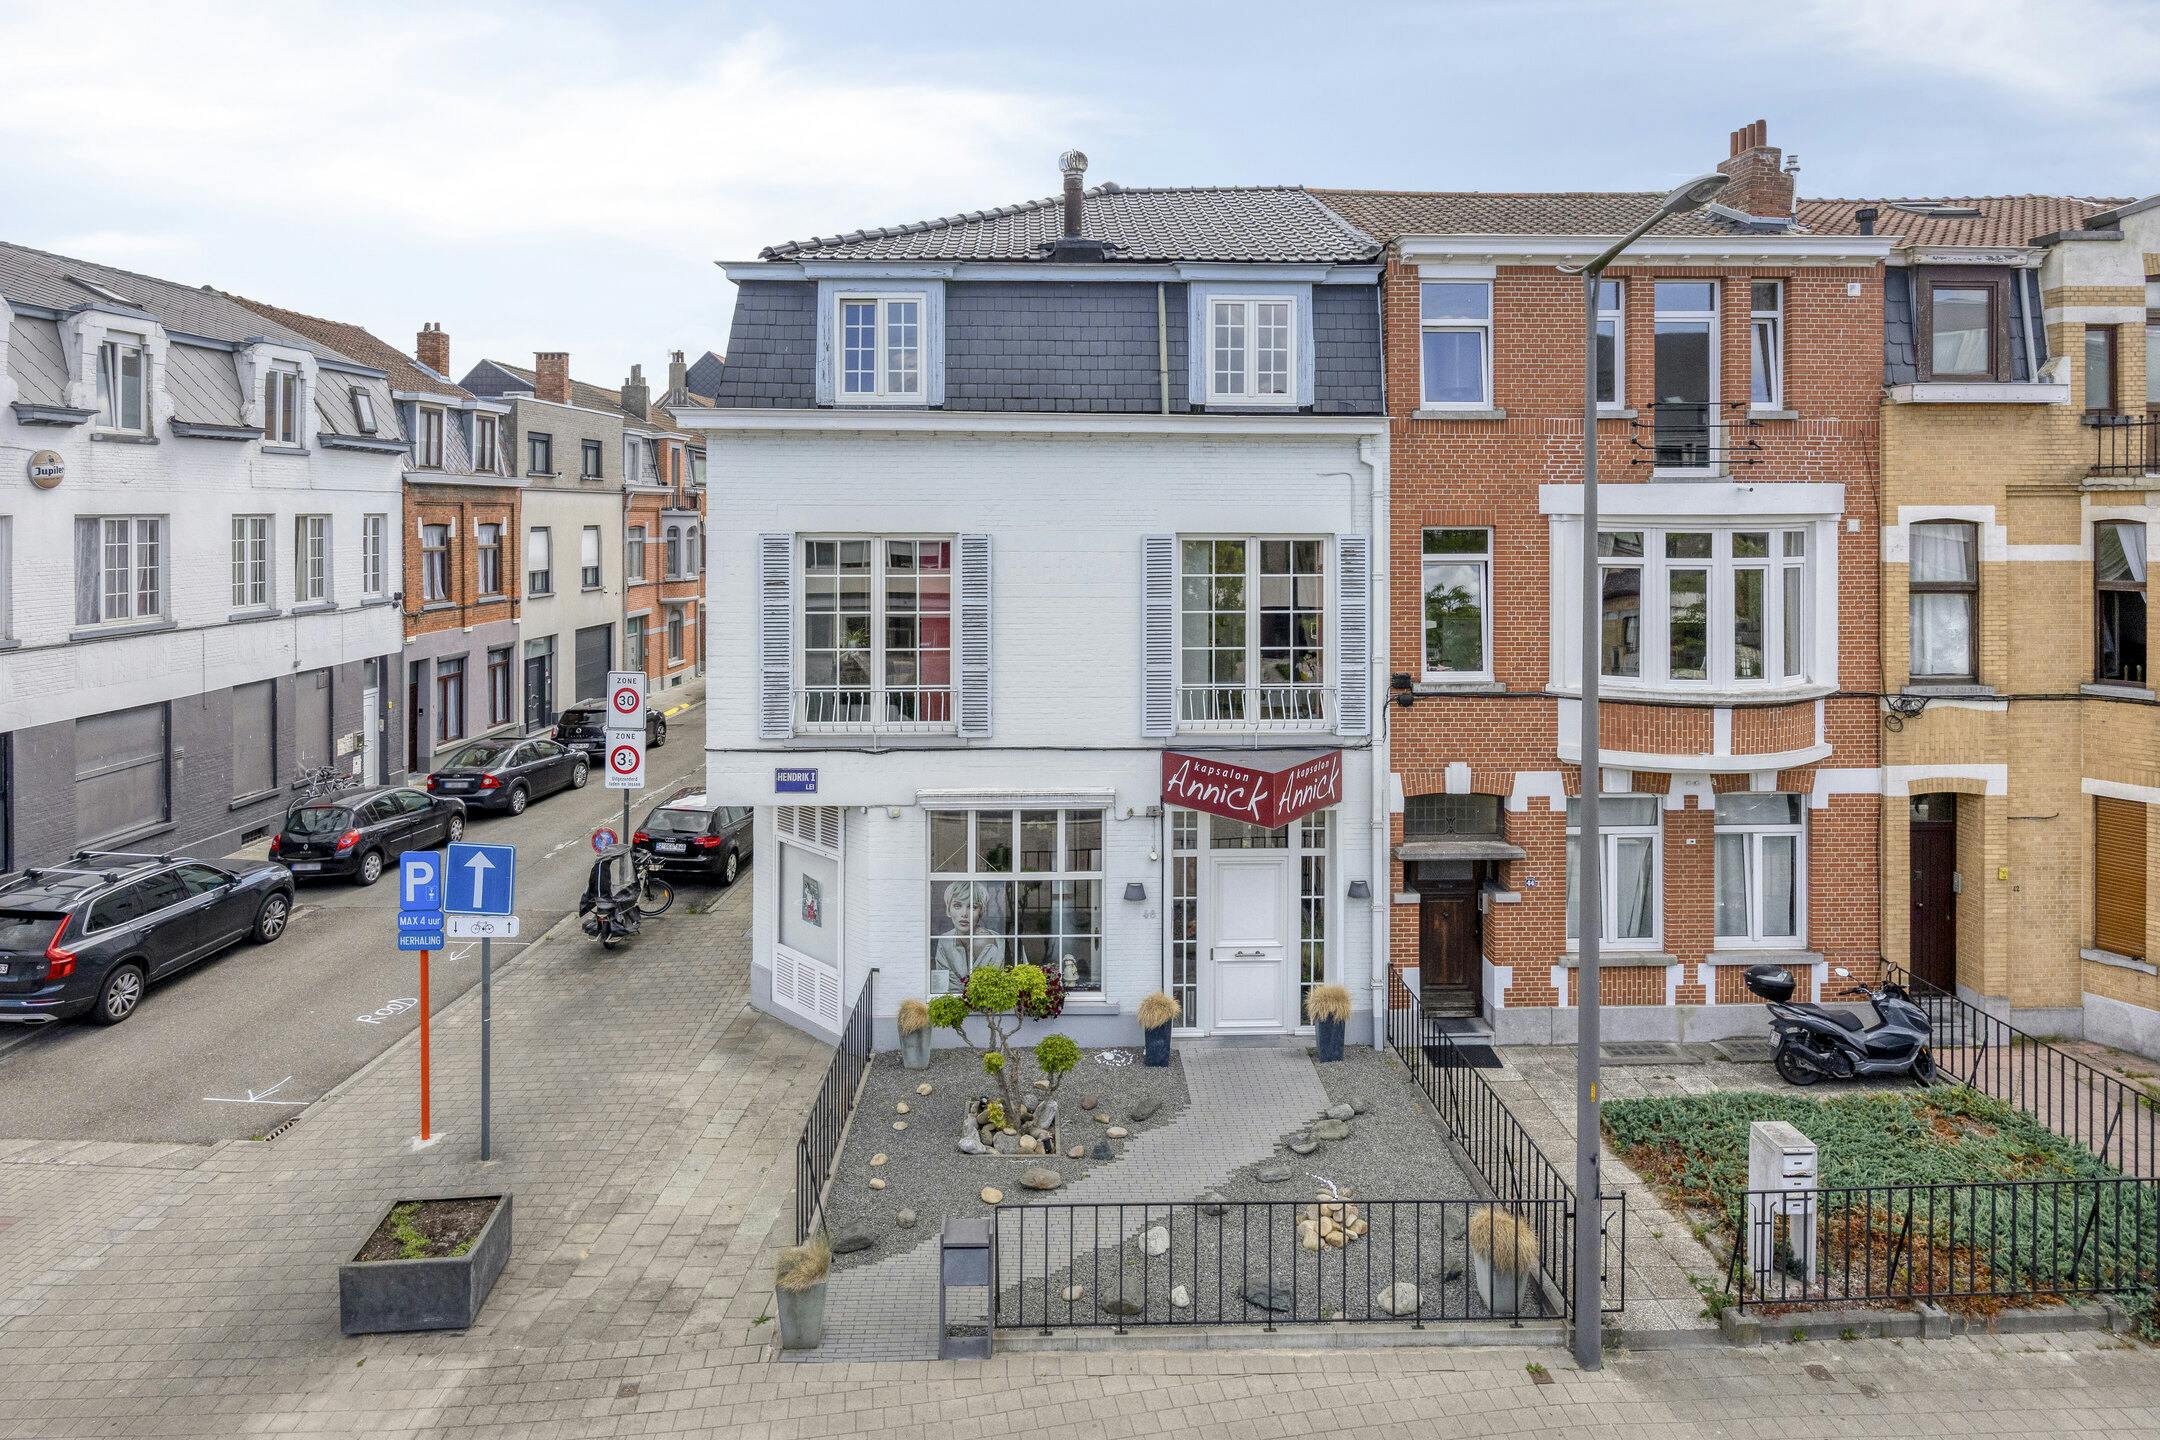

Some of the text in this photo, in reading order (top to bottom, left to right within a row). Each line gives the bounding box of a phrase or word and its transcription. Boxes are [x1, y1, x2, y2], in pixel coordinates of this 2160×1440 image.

[618, 695, 635, 706] 30
[777, 772, 816, 782] HENDRIK I
[1194, 762, 1249, 782] kapsalon
[1296, 760, 1330, 780] kapsalon
[1167, 759, 1268, 821] Annick
[1278, 756, 1340, 815] Annick
[406, 861, 434, 902] P
[400, 917, 419, 926] MAX
[420, 917, 427, 926] 4
[400, 936, 441, 946] HERHALING
